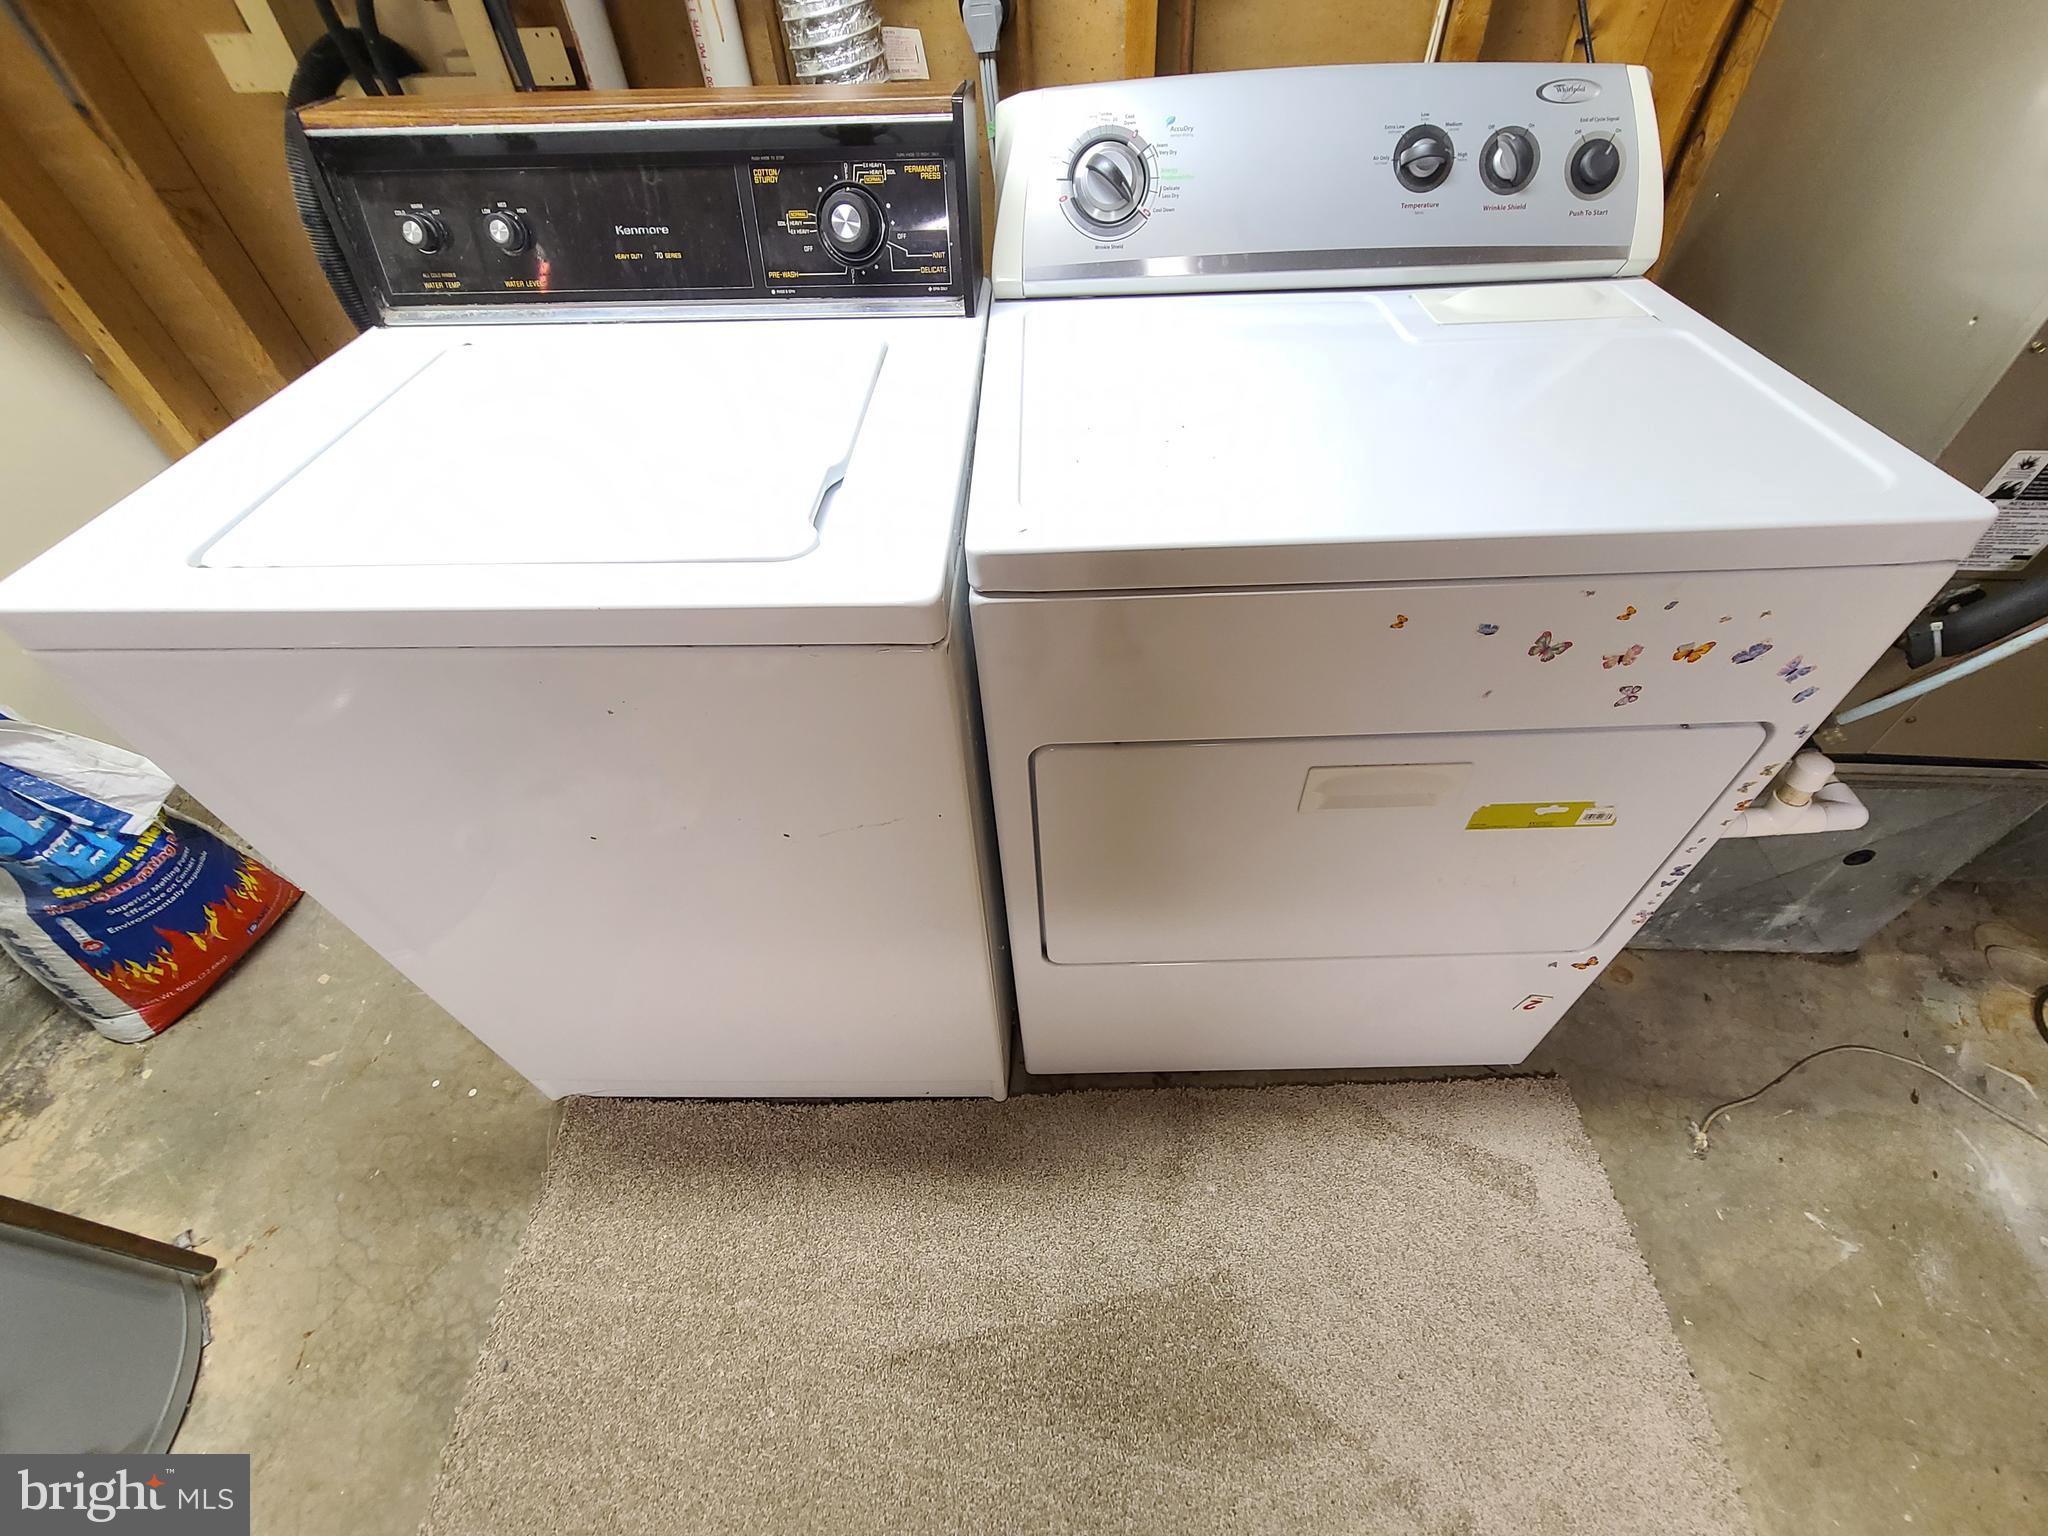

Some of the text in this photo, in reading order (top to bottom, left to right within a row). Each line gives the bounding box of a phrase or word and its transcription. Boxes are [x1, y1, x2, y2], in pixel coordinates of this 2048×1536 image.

[698, 43, 708, 59] PVC
[1553, 84, 1586, 98] Whirlpool
[753, 168, 780, 176] COTTON/
[904, 165, 940, 173] PERMANENT
[754, 176, 778, 184] STURDY
[1401, 202, 1439, 211] Temperature
[614, 225, 669, 235] Kenmore
[932, 251, 945, 259] KNIT
[424, 281, 460, 289] WATER TEMP
[525, 280, 545, 288] LEVEL
[52, 881, 102, 899] Snow
[103, 858, 133, 884] and
[106, 891, 151, 916] Superior
[151, 865, 181, 893] Melting
[123, 856, 196, 918] Effective on Contact
[107, 850, 208, 934] Environmentally Responsible
